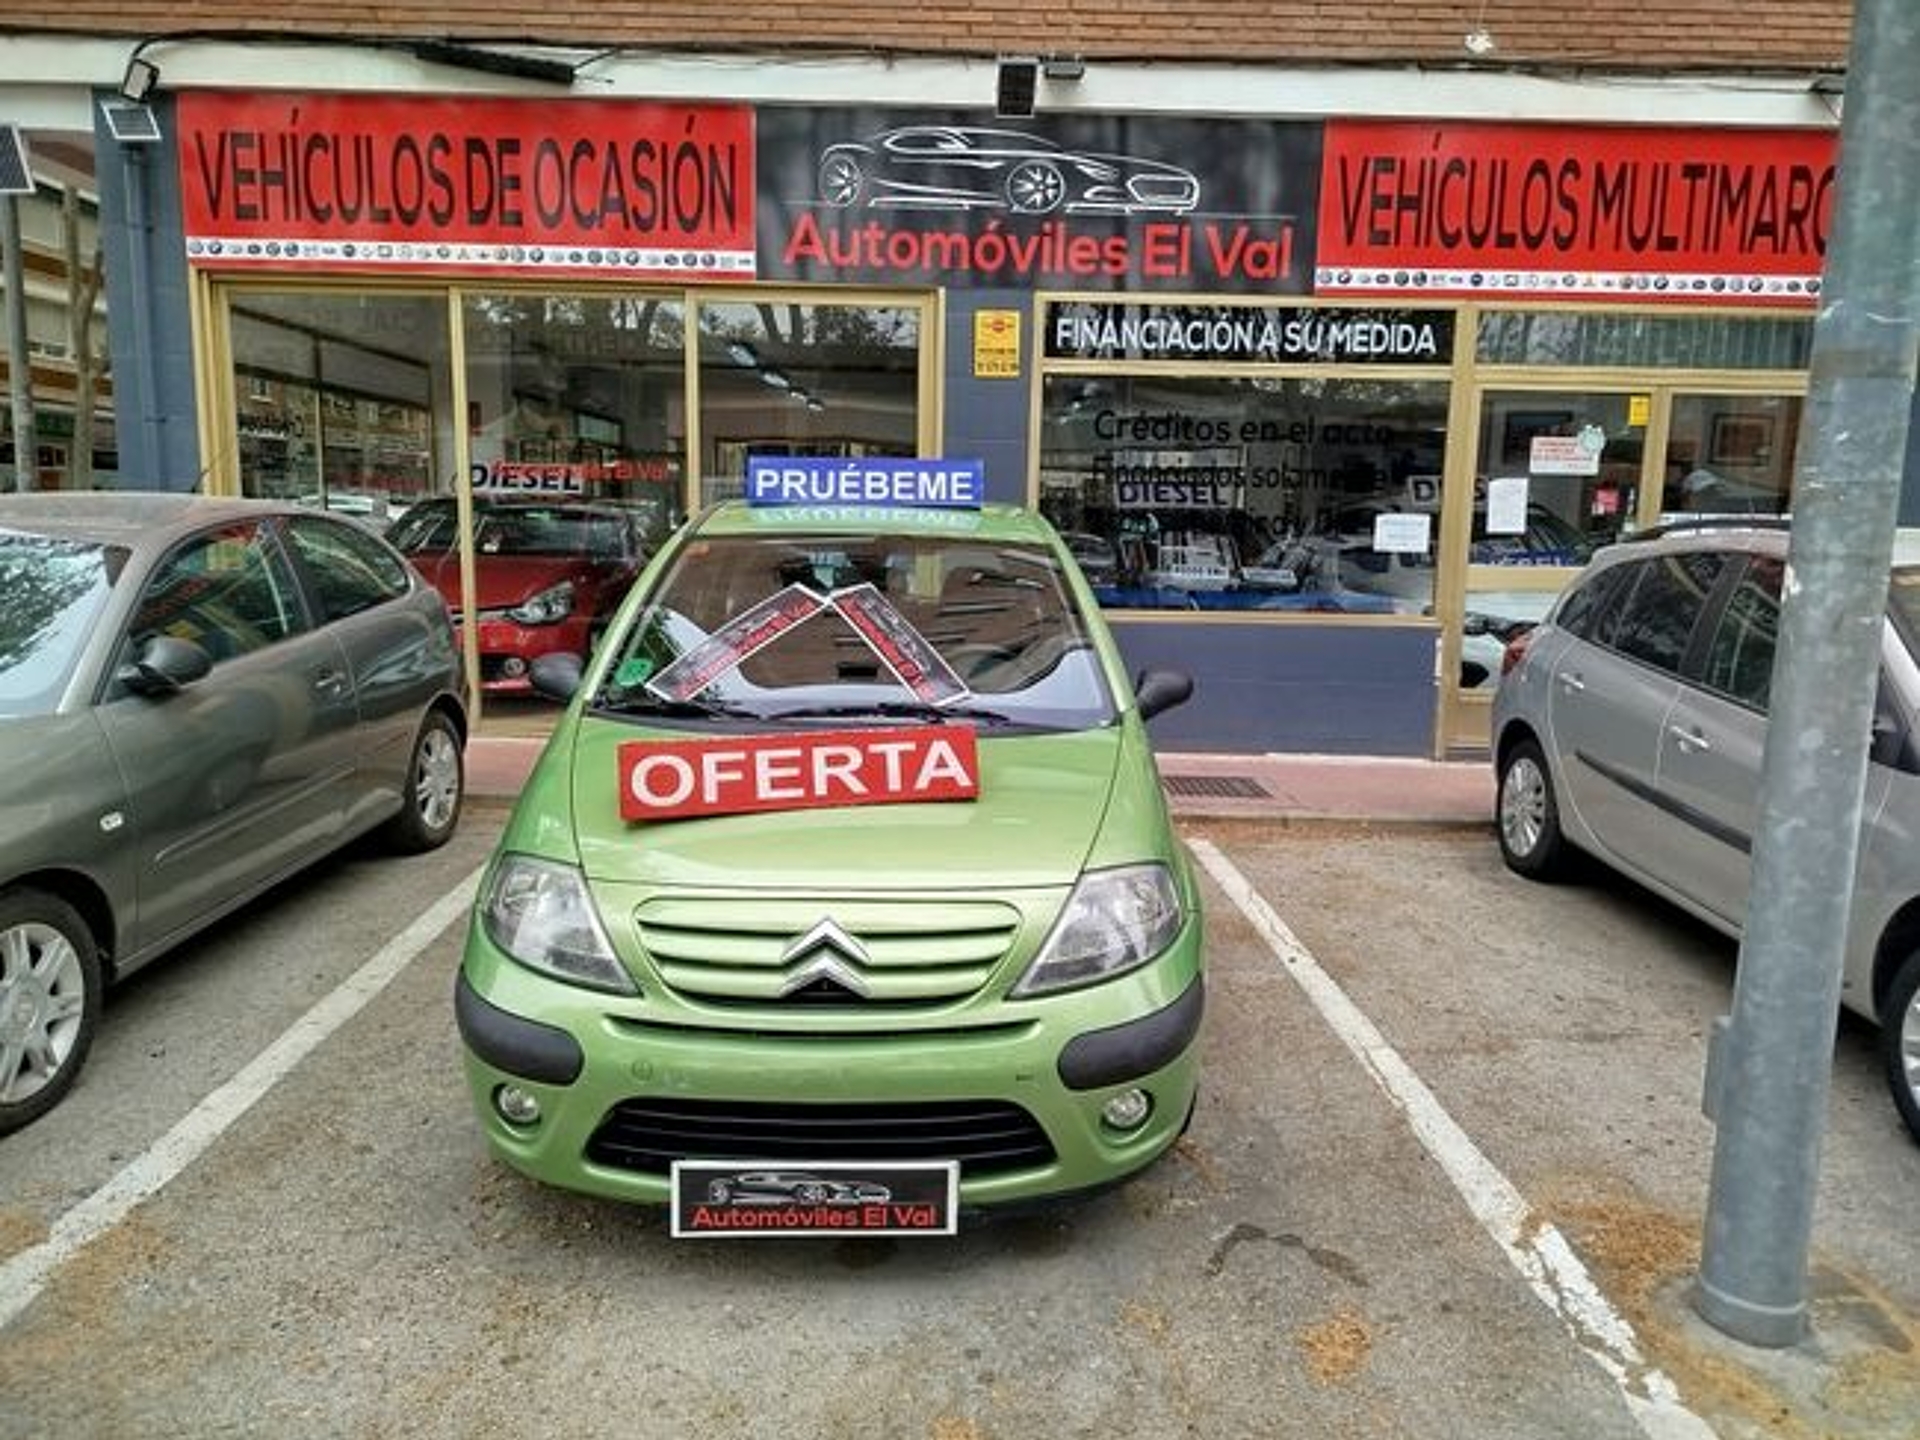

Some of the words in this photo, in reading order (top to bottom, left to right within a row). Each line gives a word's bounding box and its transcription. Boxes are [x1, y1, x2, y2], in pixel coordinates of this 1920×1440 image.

[195, 108, 452, 228] VEHÍCULOS
[464, 136, 521, 228] DE
[533, 114, 738, 233] OCASIÓN
[1339, 131, 1581, 253] VEHÍCULOS
[782, 212, 1130, 275] Automóviles
[1142, 223, 1190, 276] El
[1205, 223, 1292, 279] Val
[1056, 313, 1252, 352] FINANCIACIÓN
[1256, 322, 1279, 353] A
[1284, 322, 1323, 353] SU
[1328, 324, 1437, 355] MEDIDA
[1094, 410, 1231, 443] Créditos
[1239, 420, 1281, 443] en
[1290, 414, 1315, 444] el
[755, 462, 975, 501] PRUÉBEME
[1118, 480, 1228, 504] DIESEL
[630, 738, 974, 808] OFERTA
[691, 1203, 859, 1228] Automóviles
[863, 1205, 888, 1228] El
[895, 1204, 936, 1228] Val
